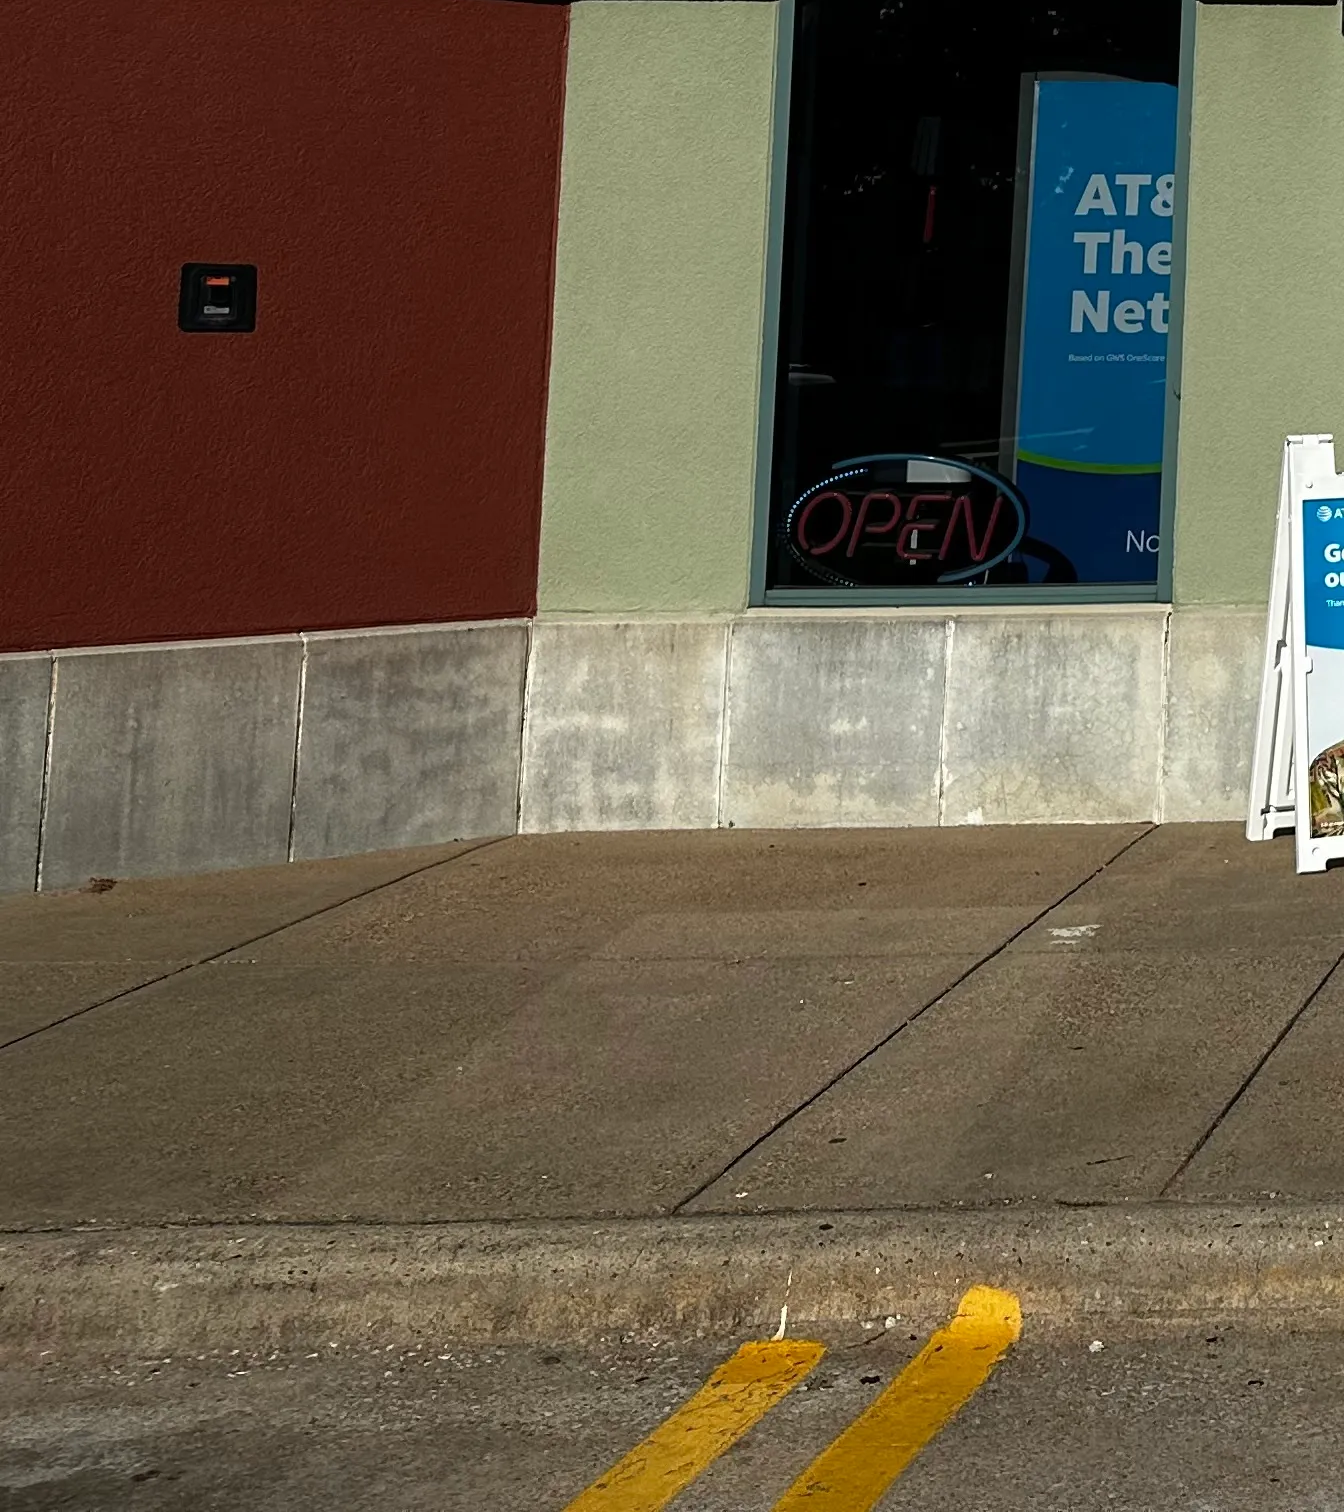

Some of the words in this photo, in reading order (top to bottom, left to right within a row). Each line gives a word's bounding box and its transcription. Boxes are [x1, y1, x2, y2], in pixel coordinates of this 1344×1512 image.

[1073, 229, 1173, 275] The
[1068, 353, 1093, 362] Based
[1094, 354, 1105, 362] on
[797, 491, 1003, 561] OPEN
